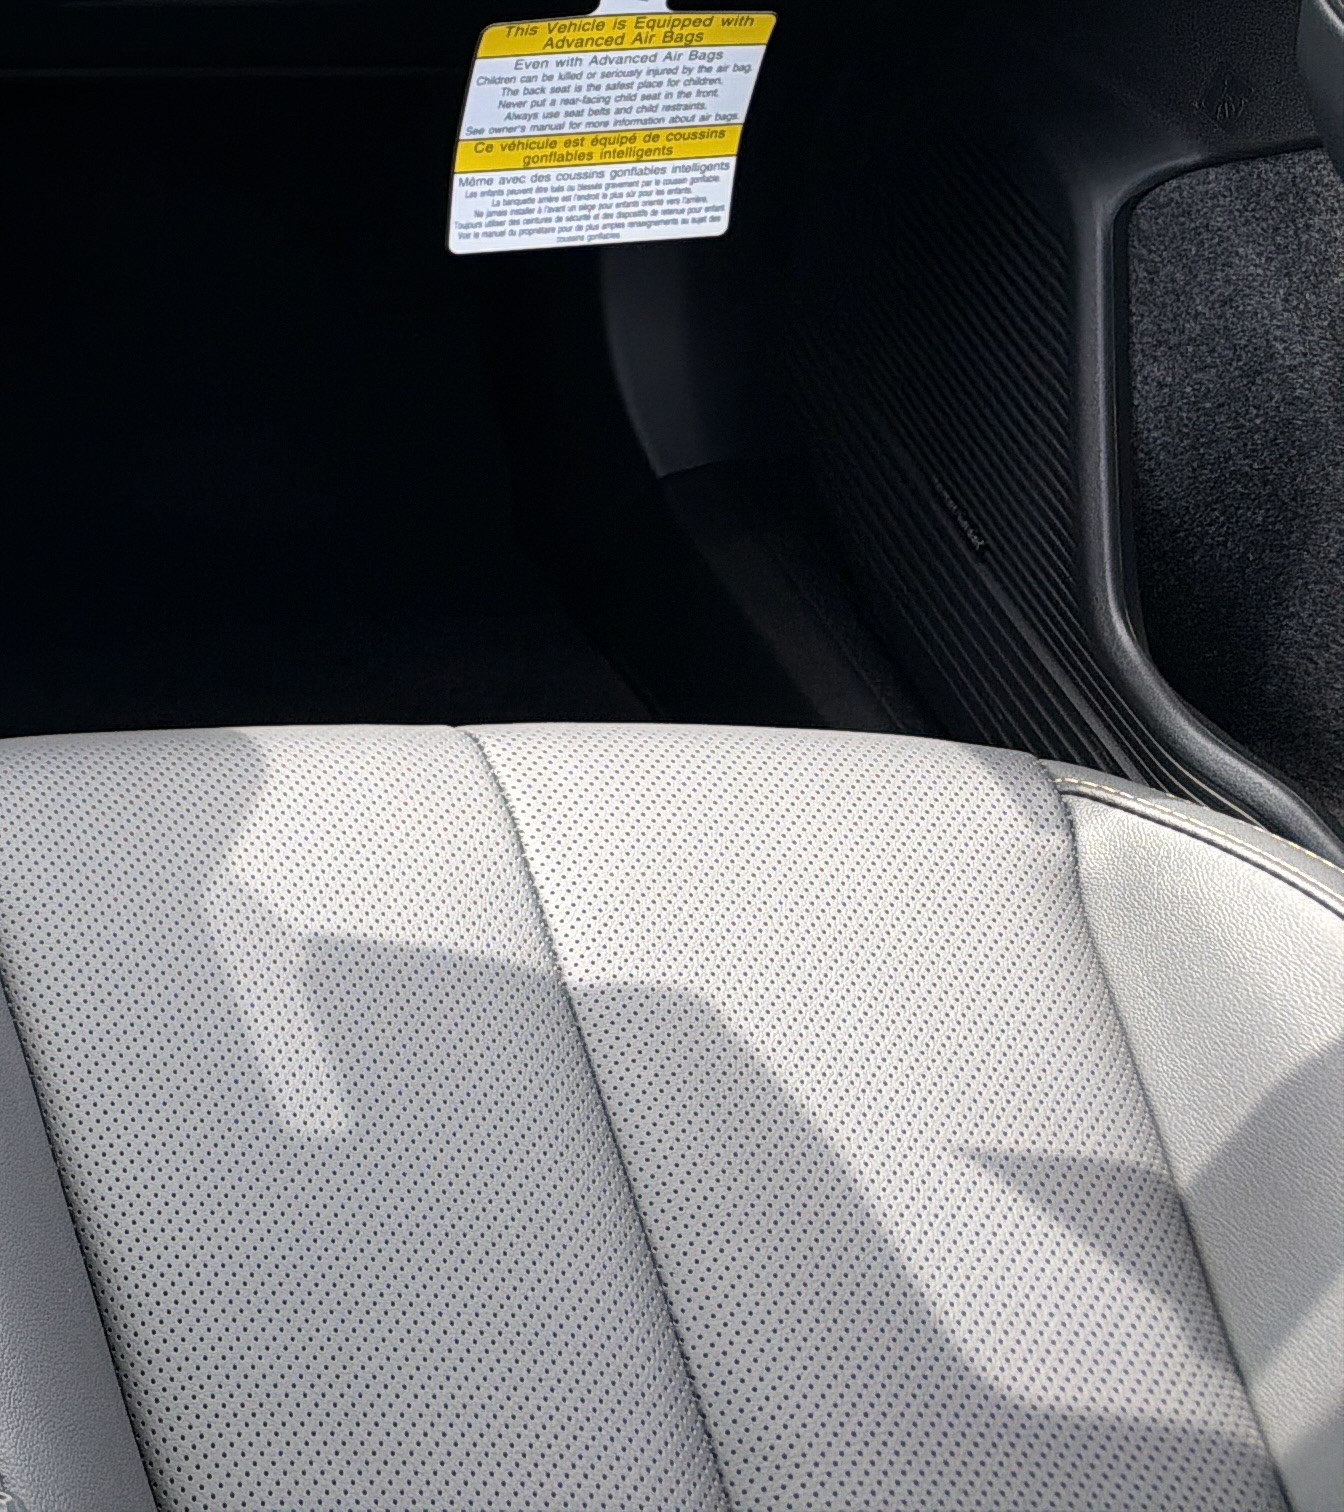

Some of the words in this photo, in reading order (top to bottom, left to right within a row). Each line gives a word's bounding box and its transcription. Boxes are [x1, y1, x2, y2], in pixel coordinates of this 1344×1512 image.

[504, 25, 538, 38] This
[547, 18, 605, 34] Vehicle
[612, 18, 626, 30] is
[634, 15, 714, 32] Equipped
[720, 15, 755, 28] with
[542, 33, 624, 50] Advanced
[632, 33, 656, 45] Air
[662, 31, 704, 47] Bags
[514, 59, 549, 71] Even
[555, 56, 583, 68] with
[589, 52, 658, 66] Advanced
[662, 51, 683, 62] Air
[688, 49, 724, 63] Bags
[476, 76, 516, 86] Children
[520, 75, 538, 83] can
[541, 73, 554, 82] be
[587, 71, 596, 79] or
[697, 64, 713, 73] the
[501, 87, 519, 97] The
[523, 85, 546, 95] back
[586, 83, 602, 92] the
[677, 89, 693, 99] the
[473, 141, 494, 154] Ce
[500, 138, 557, 153] véhicule
[563, 137, 585, 149] est
[643, 131, 660, 144] de
[665, 129, 726, 142] coussins
[522, 150, 594, 167] gonflables
[599, 145, 674, 162] intelligents
[499, 173, 526, 185] avec
[530, 172, 551, 183] des
[555, 169, 605, 182] coussins
[609, 165, 667, 180] gonflables
[670, 161, 731, 175] intelligents
